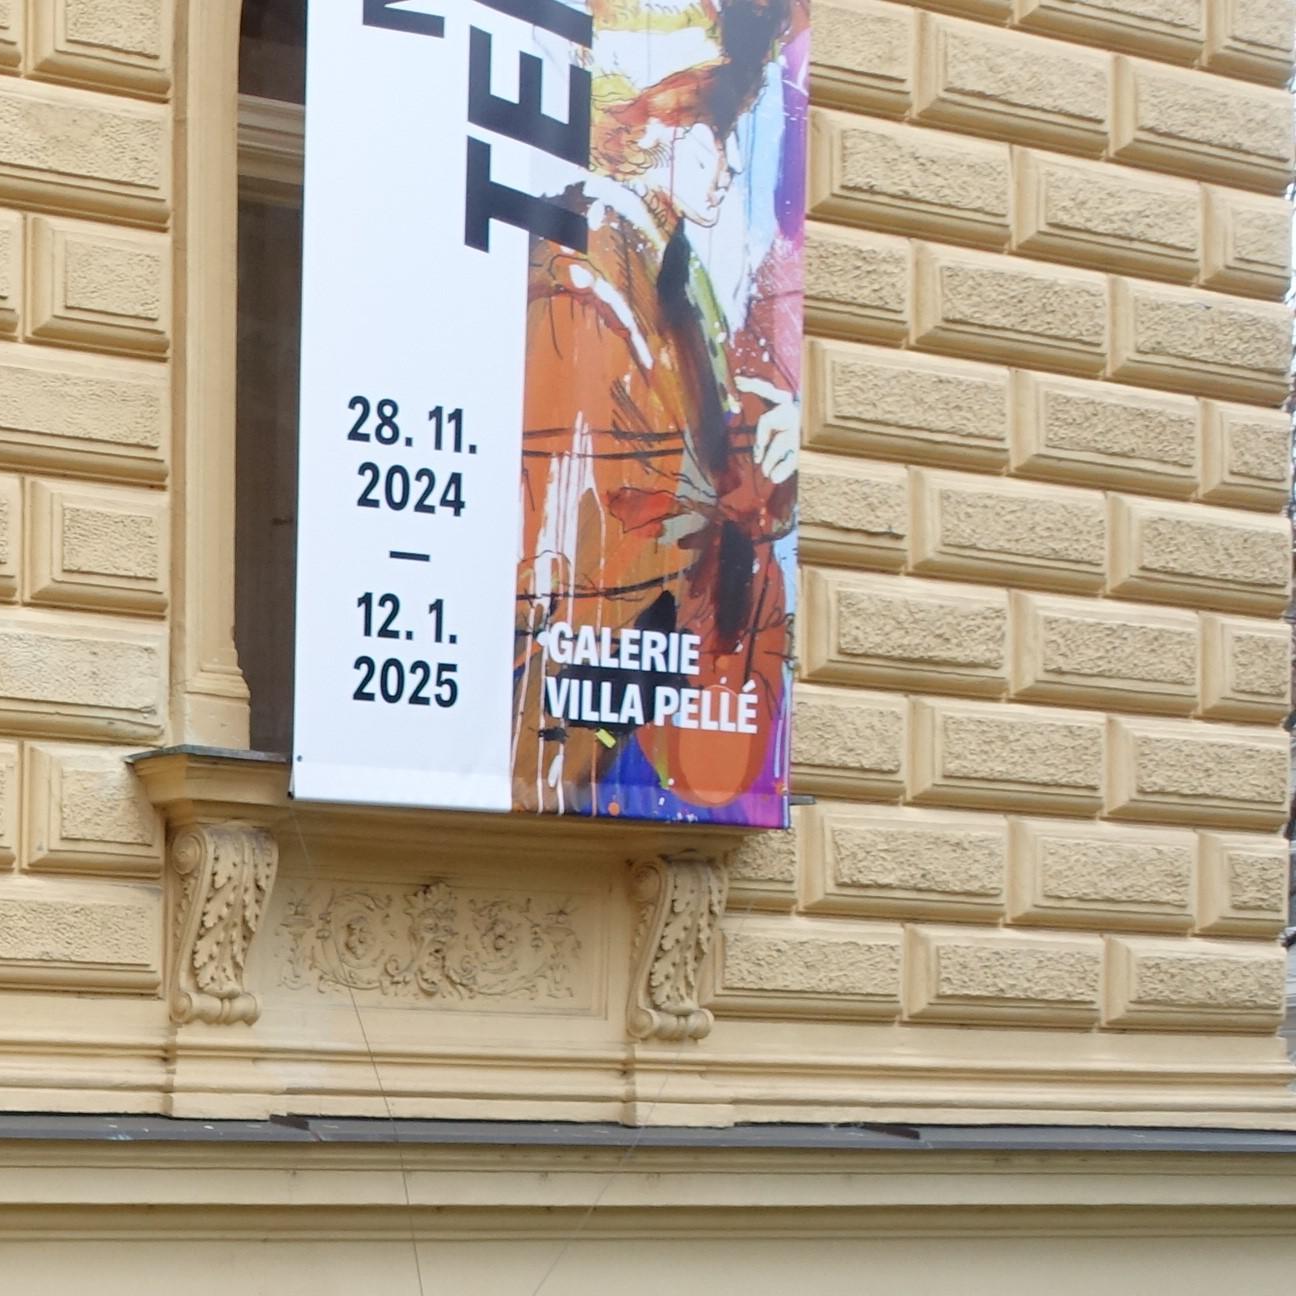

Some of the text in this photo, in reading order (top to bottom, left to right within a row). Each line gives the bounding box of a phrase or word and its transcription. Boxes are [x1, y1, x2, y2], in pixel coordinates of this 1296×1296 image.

[464, 0, 593, 255] TE
[347, 395, 477, 454] 28. 11.
[356, 461, 466, 517] 2024
[357, 592, 457, 644] 12. 1.
[547, 621, 701, 676] GALERIE
[353, 655, 458, 708] 2025
[545, 675, 759, 735] VILLA PELLÉ
